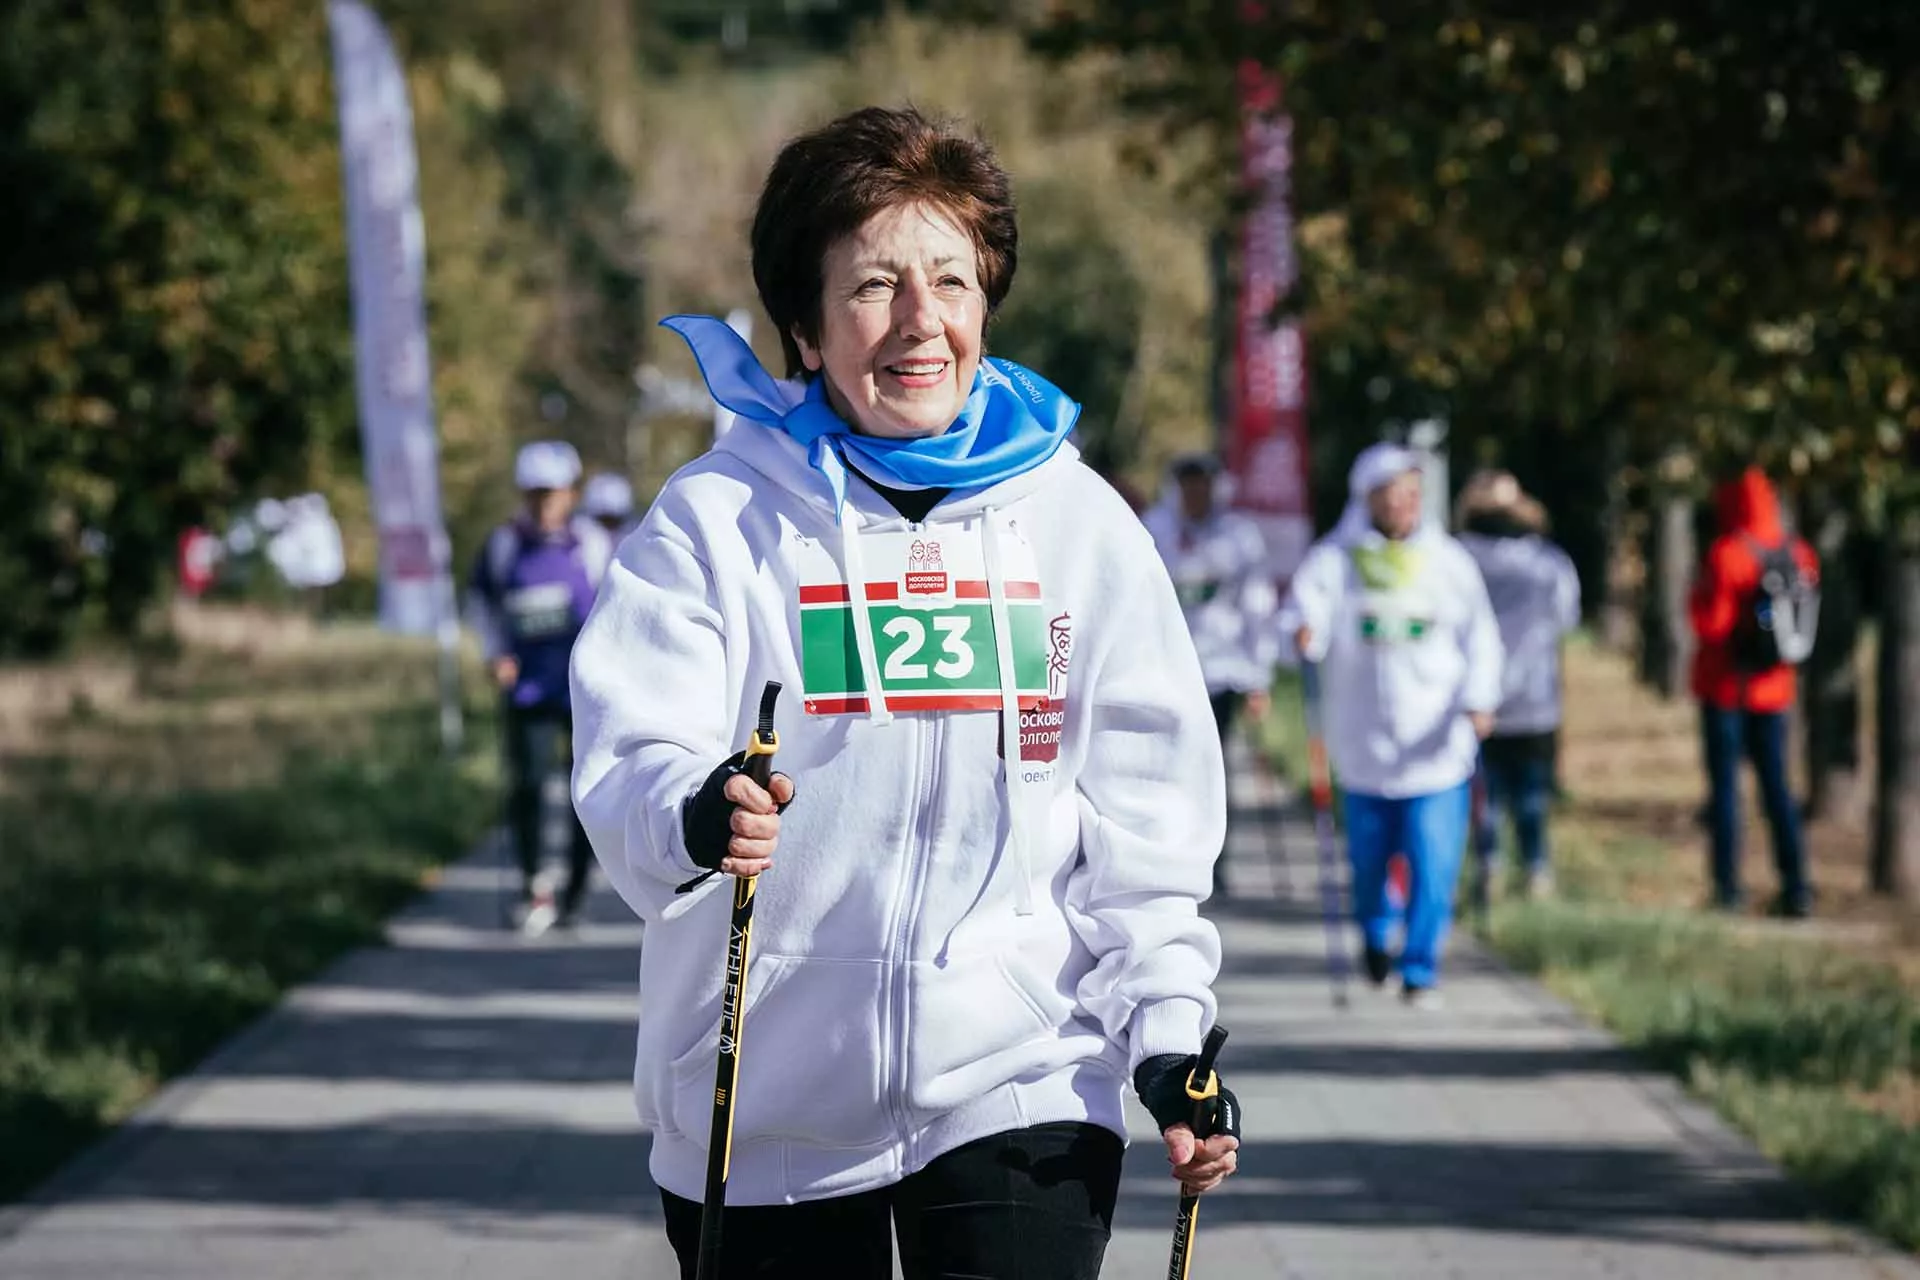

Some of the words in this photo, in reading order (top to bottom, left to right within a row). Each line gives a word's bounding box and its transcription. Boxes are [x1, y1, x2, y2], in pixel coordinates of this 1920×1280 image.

[1014, 371, 1045, 404] Проект
[882, 616, 975, 680] 23
[721, 925, 743, 1030] ATHLETIC
